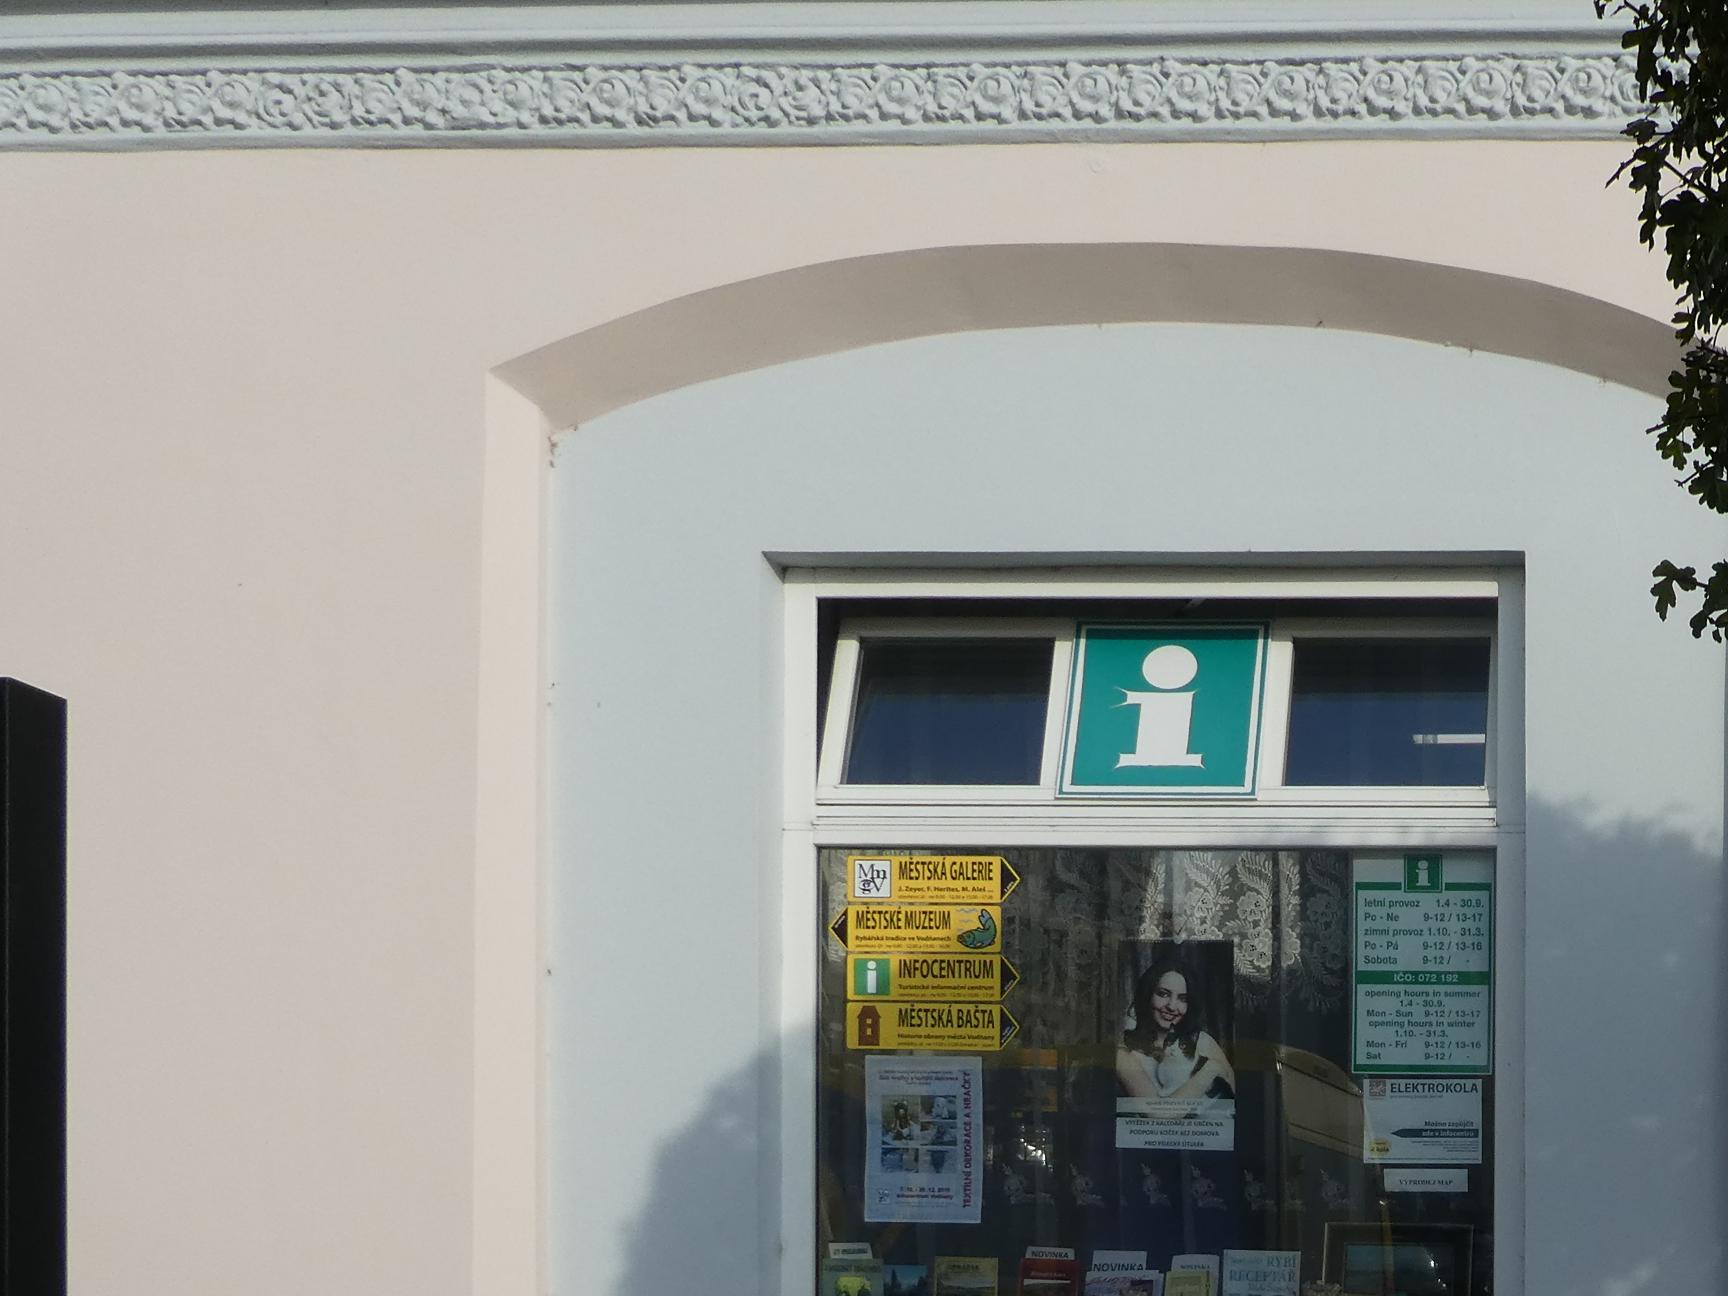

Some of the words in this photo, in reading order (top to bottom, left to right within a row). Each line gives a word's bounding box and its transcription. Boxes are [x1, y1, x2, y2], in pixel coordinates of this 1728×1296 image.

[898, 857, 948, 881] MĚSTSKÁ
[950, 861, 994, 881] GALERIE
[1364, 898, 1386, 908] letní
[1389, 901, 1421, 910] provoz
[1436, 898, 1450, 908] 1.4
[1460, 898, 1484, 908] 30.9.
[855, 906, 902, 930] MĚSTSKÉ
[904, 910, 951, 930] MUZEUM
[1364, 912, 1376, 922] Po
[1386, 912, 1399, 922] Ne
[1423, 913, 1445, 923] 9-12
[1455, 913, 1483, 922] 13-17
[1364, 927, 1390, 937] zimní
[1392, 929, 1424, 939] provoz
[1427, 927, 1451, 937] 1.10.
[1460, 927, 1484, 937] 31.3.
[1364, 941, 1376, 951] Po
[1386, 941, 1399, 951] Pá
[1422, 941, 1445, 951] 9-12
[1455, 941, 1482, 951] 13-16
[1363, 956, 1398, 965] Sobota
[1422, 956, 1444, 965] 9-12
[898, 959, 994, 979] INFOCENTRUM
[1393, 971, 1415, 982] IČO:
[1418, 974, 1437, 983] 072
[1439, 974, 1459, 983] 192
[1364, 990, 1401, 999] opening
[1403, 989, 1429, 998] hours
[1432, 990, 1441, 998] in
[1399, 1000, 1413, 1008] 1.4
[1422, 1000, 1445, 1008] 30.9.
[898, 1004, 954, 1028] MĚSTSKÁ
[957, 1005, 996, 1029] BAŠTA
[1368, 1019, 1405, 1029] opening
[1407, 1019, 1433, 1028] hours
[1436, 1019, 1445, 1028] in
[1447, 1019, 1476, 1028] winter
[1366, 1040, 1386, 1048] Mon
[1395, 1040, 1407, 1048] Fri
[1424, 1040, 1446, 1048] 9-12
[1455, 1040, 1482, 1048] 13-16
[1366, 1052, 1381, 1060] Sat
[1424, 1052, 1446, 1060] 9-12
[1390, 1082, 1479, 1094] ELEKTROKOLA
[1031, 1250, 1070, 1258] NOVINKA
[1093, 1262, 1145, 1272] NOVINKA
